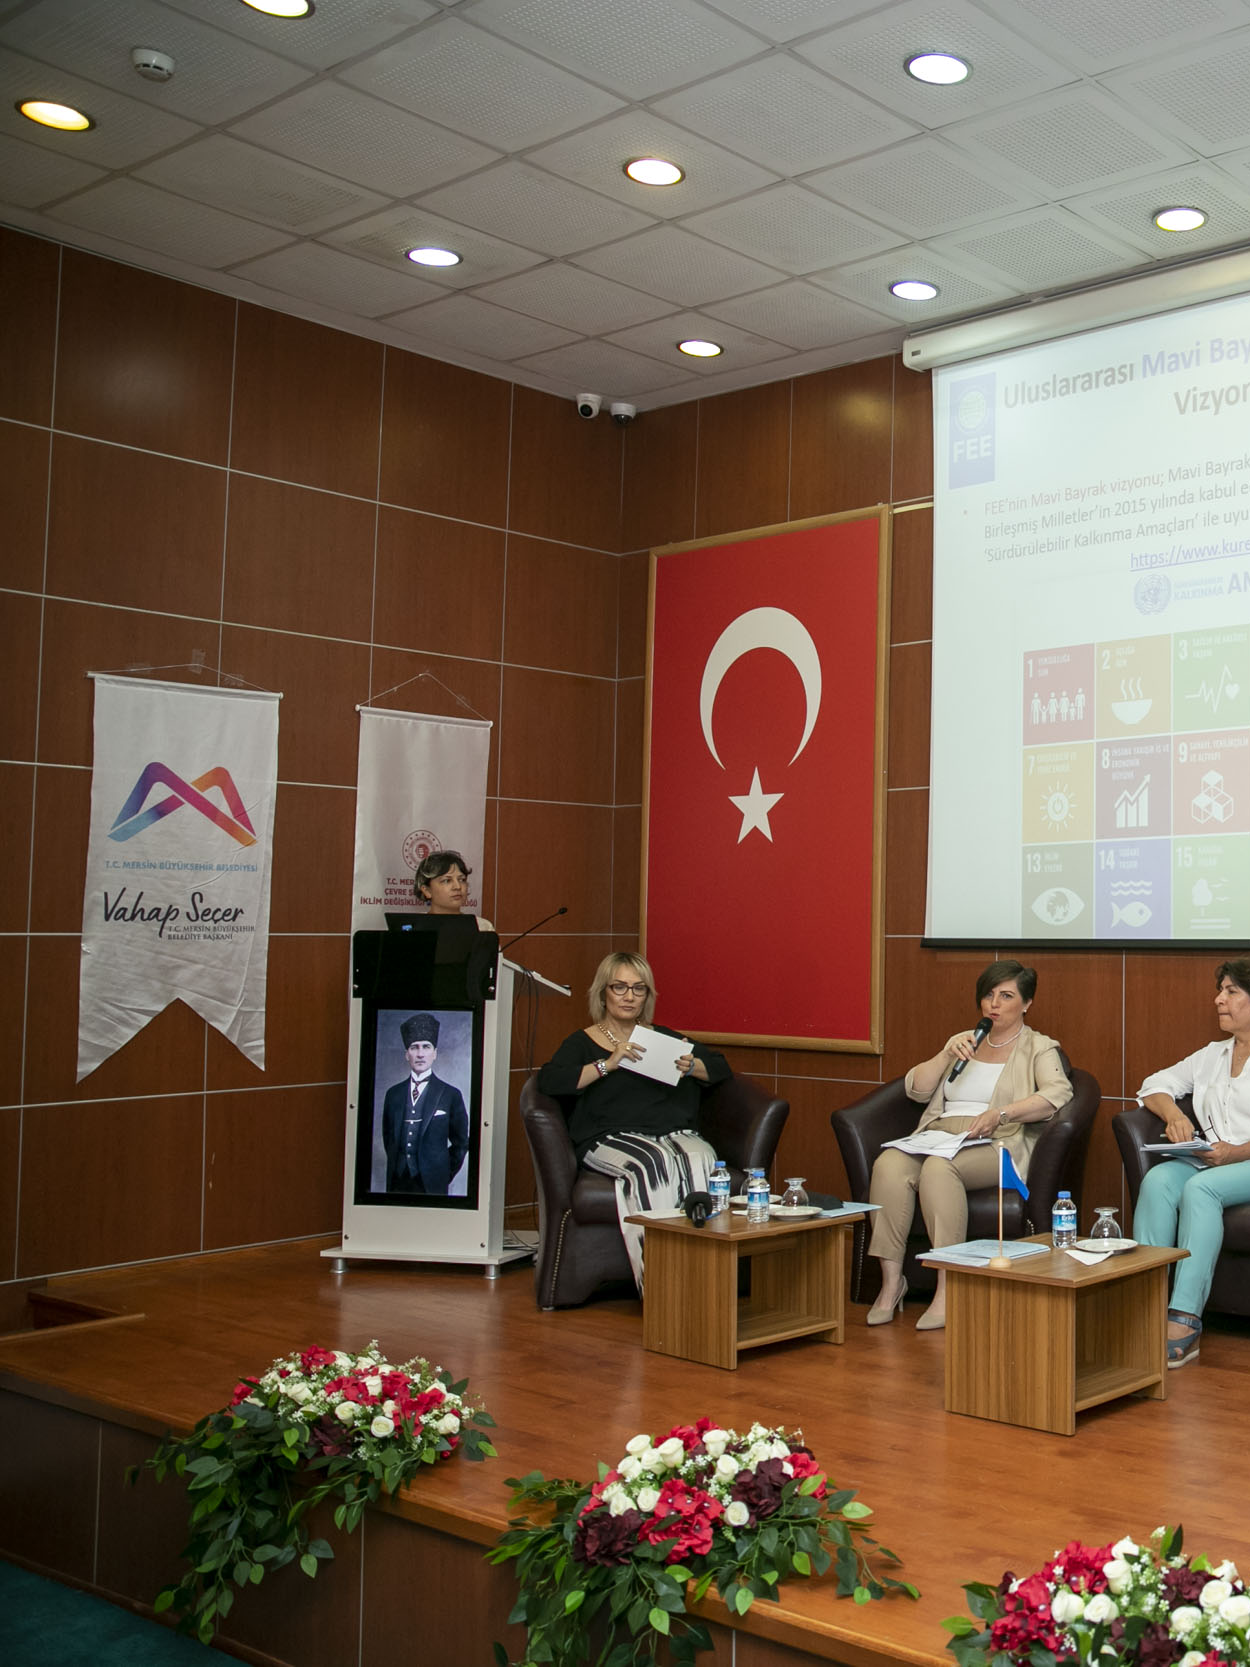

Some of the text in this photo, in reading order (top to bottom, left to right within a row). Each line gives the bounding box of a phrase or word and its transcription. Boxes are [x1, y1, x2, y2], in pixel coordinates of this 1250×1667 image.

[1003, 362, 1135, 409] Uluslararası
[1141, 340, 1201, 379] Mavi
[952, 435, 993, 463] FEE
[984, 497, 1028, 516] FEE'nin
[1031, 488, 1061, 508] Mavi
[1064, 480, 1107, 502] Bayrak
[1110, 472, 1165, 495] vizyonu;
[1168, 463, 1201, 484] Mavi
[984, 519, 1038, 540] Birleşmiş
[1041, 505, 1111, 529] Milletler'in
[1114, 499, 1146, 519] 2015
[1150, 488, 1195, 513] yılında
[1199, 480, 1236, 502] kabul
[1073, 527, 1133, 549] Kalkınma
[1202, 511, 1220, 528] ile
[1101, 649, 1111, 670] 2
[1178, 639, 1188, 660] 3
[1026, 659, 1034, 679] 1
[1101, 749, 1111, 769] 8
[1178, 742, 1188, 763] 9
[1027, 754, 1036, 776] 7
[105, 861, 121, 869] T.C.
[122, 860, 157, 870] MERSİN
[159, 861, 213, 872] BÜYÜKŞEHİR
[1026, 852, 1041, 873] 13
[1098, 849, 1116, 871] 14
[1175, 846, 1193, 867] 15
[360, 896, 382, 905] İKLİM
[103, 887, 245, 938] Vahap Seçer
